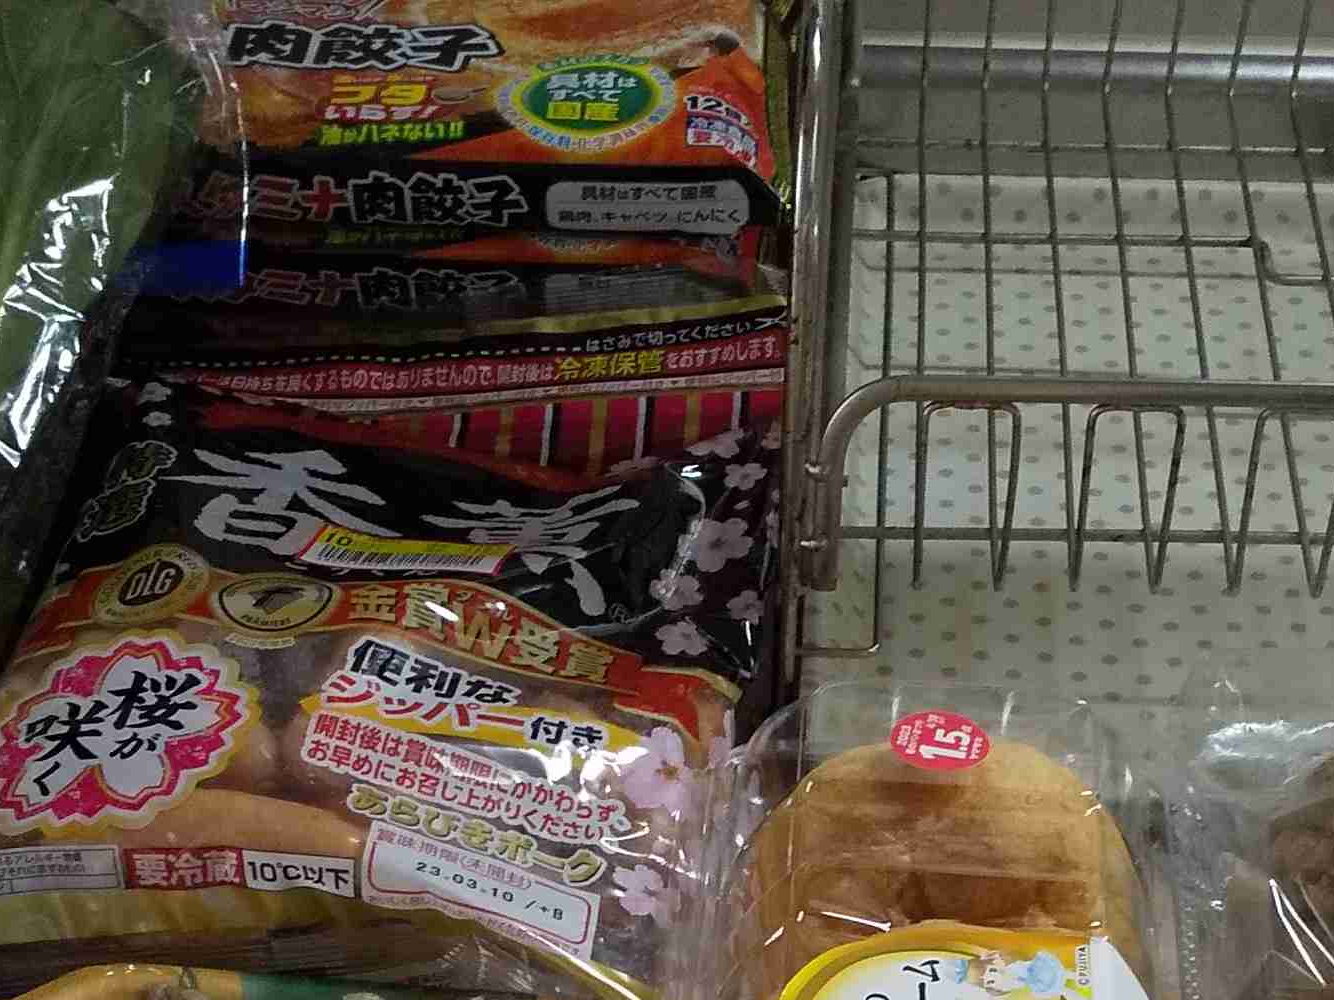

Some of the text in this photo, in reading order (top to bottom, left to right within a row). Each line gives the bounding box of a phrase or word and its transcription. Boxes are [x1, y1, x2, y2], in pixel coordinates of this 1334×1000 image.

[227, 22, 501, 70] 肉餃子
[586, 319, 754, 352] はさみで切ってください
[124, 561, 178, 601] DLG
[349, 640, 515, 705] 便利な
[324, 674, 605, 748] ジッパー付き
[306, 738, 606, 841] お早めにお召し上がりください
[348, 784, 607, 886] あらびきポーク
[133, 851, 240, 886] 要冷蔵
